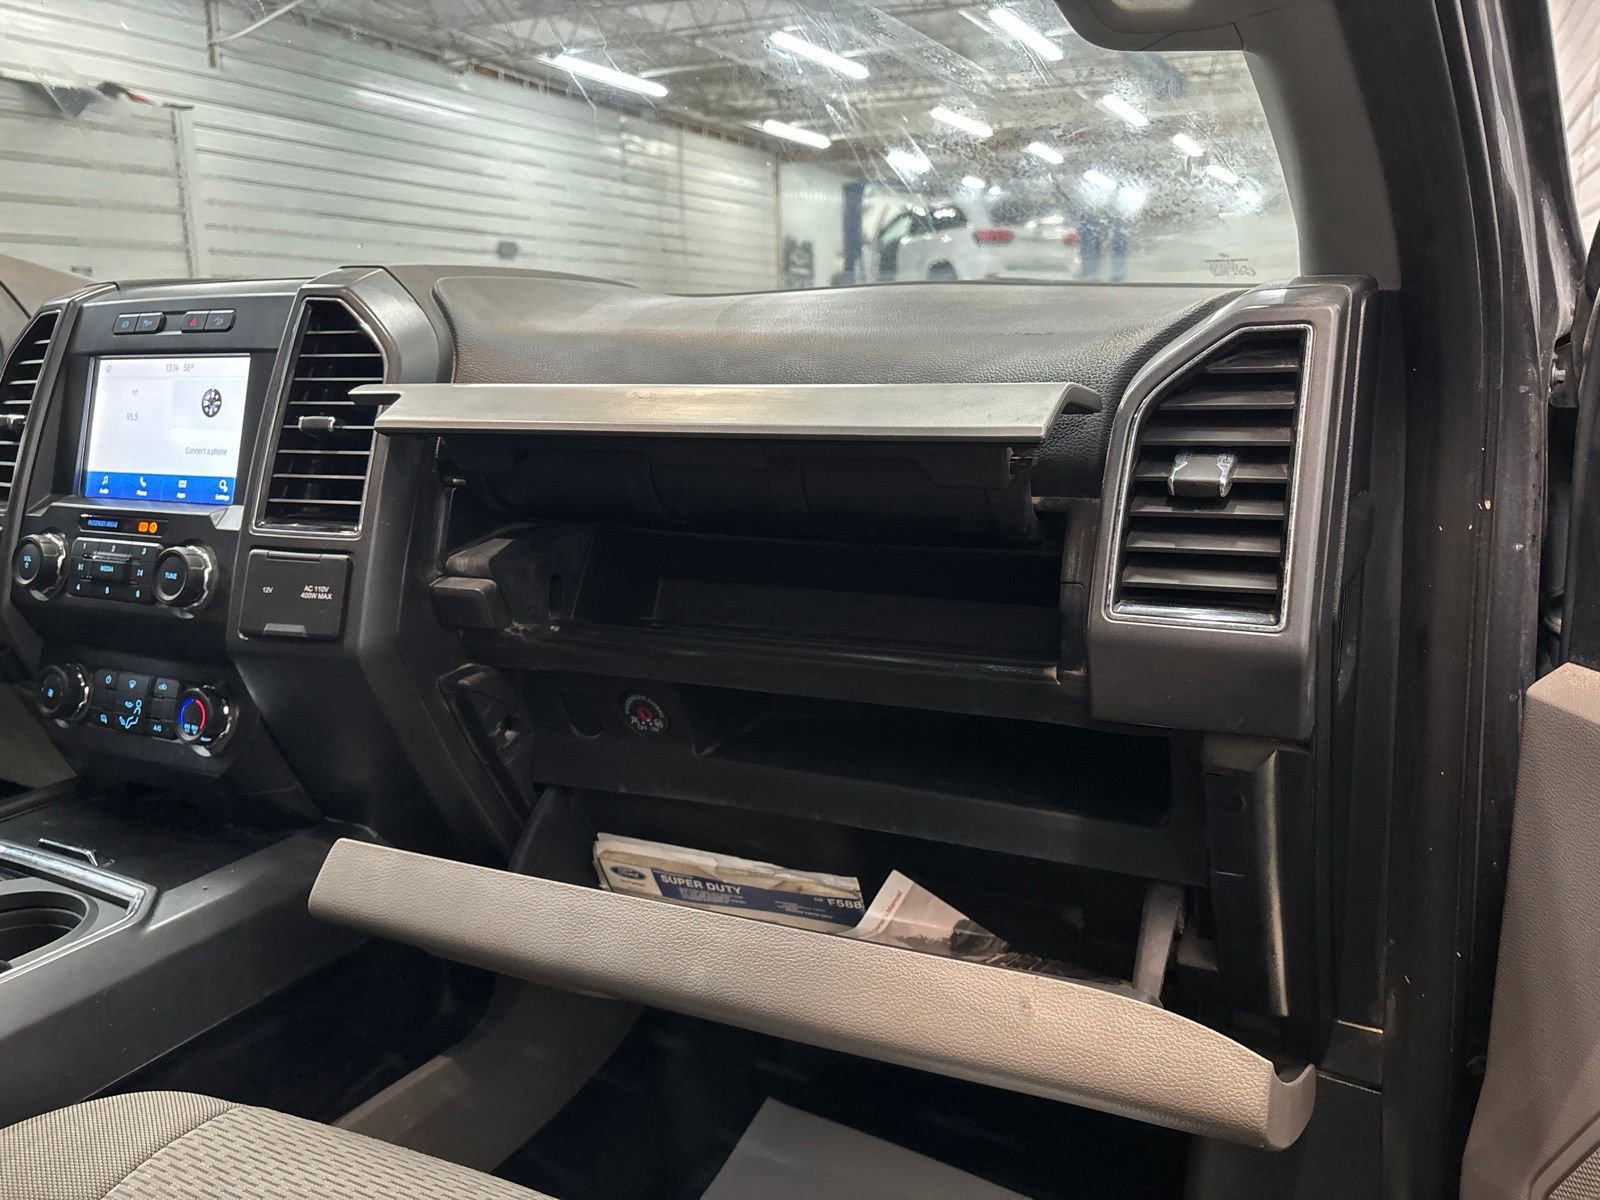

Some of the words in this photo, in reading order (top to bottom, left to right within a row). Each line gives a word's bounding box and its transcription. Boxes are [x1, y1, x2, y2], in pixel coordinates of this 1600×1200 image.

[185, 446, 206, 455] Connect
[211, 447, 228, 456] phone
[141, 547, 147, 556] 3
[164, 572, 178, 580] TUNE
[262, 586, 274, 594] 12V
[300, 592, 318, 600] 400W
[660, 874, 704, 890] SUPER
[706, 882, 743, 895] DUTY
